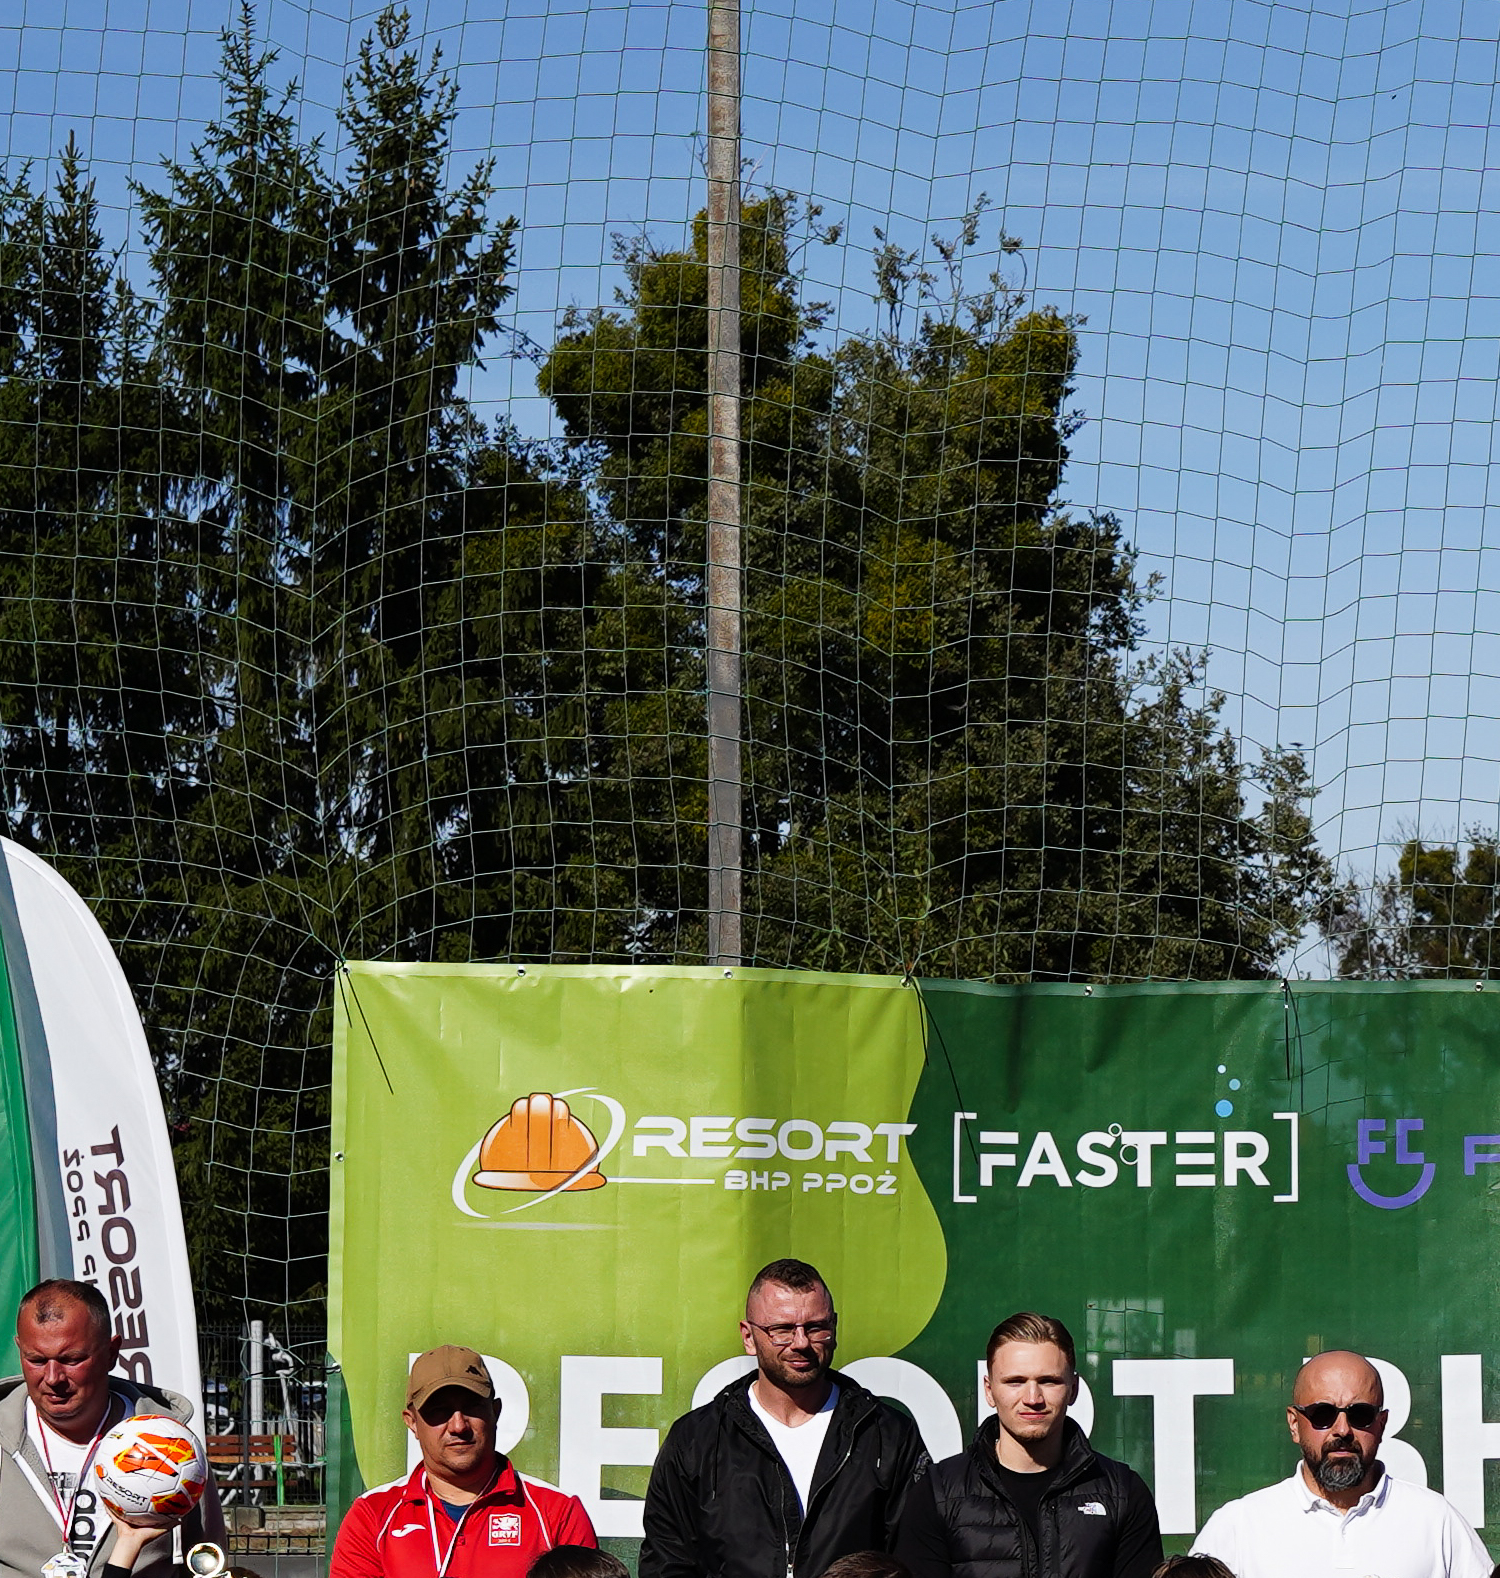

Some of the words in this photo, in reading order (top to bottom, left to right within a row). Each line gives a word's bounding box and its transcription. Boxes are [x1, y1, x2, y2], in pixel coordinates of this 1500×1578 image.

[632, 1116, 918, 1162] RESORT
[723, 1170, 791, 1191] BHP
[803, 1169, 898, 1196] PPOŻ
[407, 1354, 1235, 1537] REOT
[106, 1476, 151, 1506] RESORT
[491, 1531, 519, 1540] GRYF
